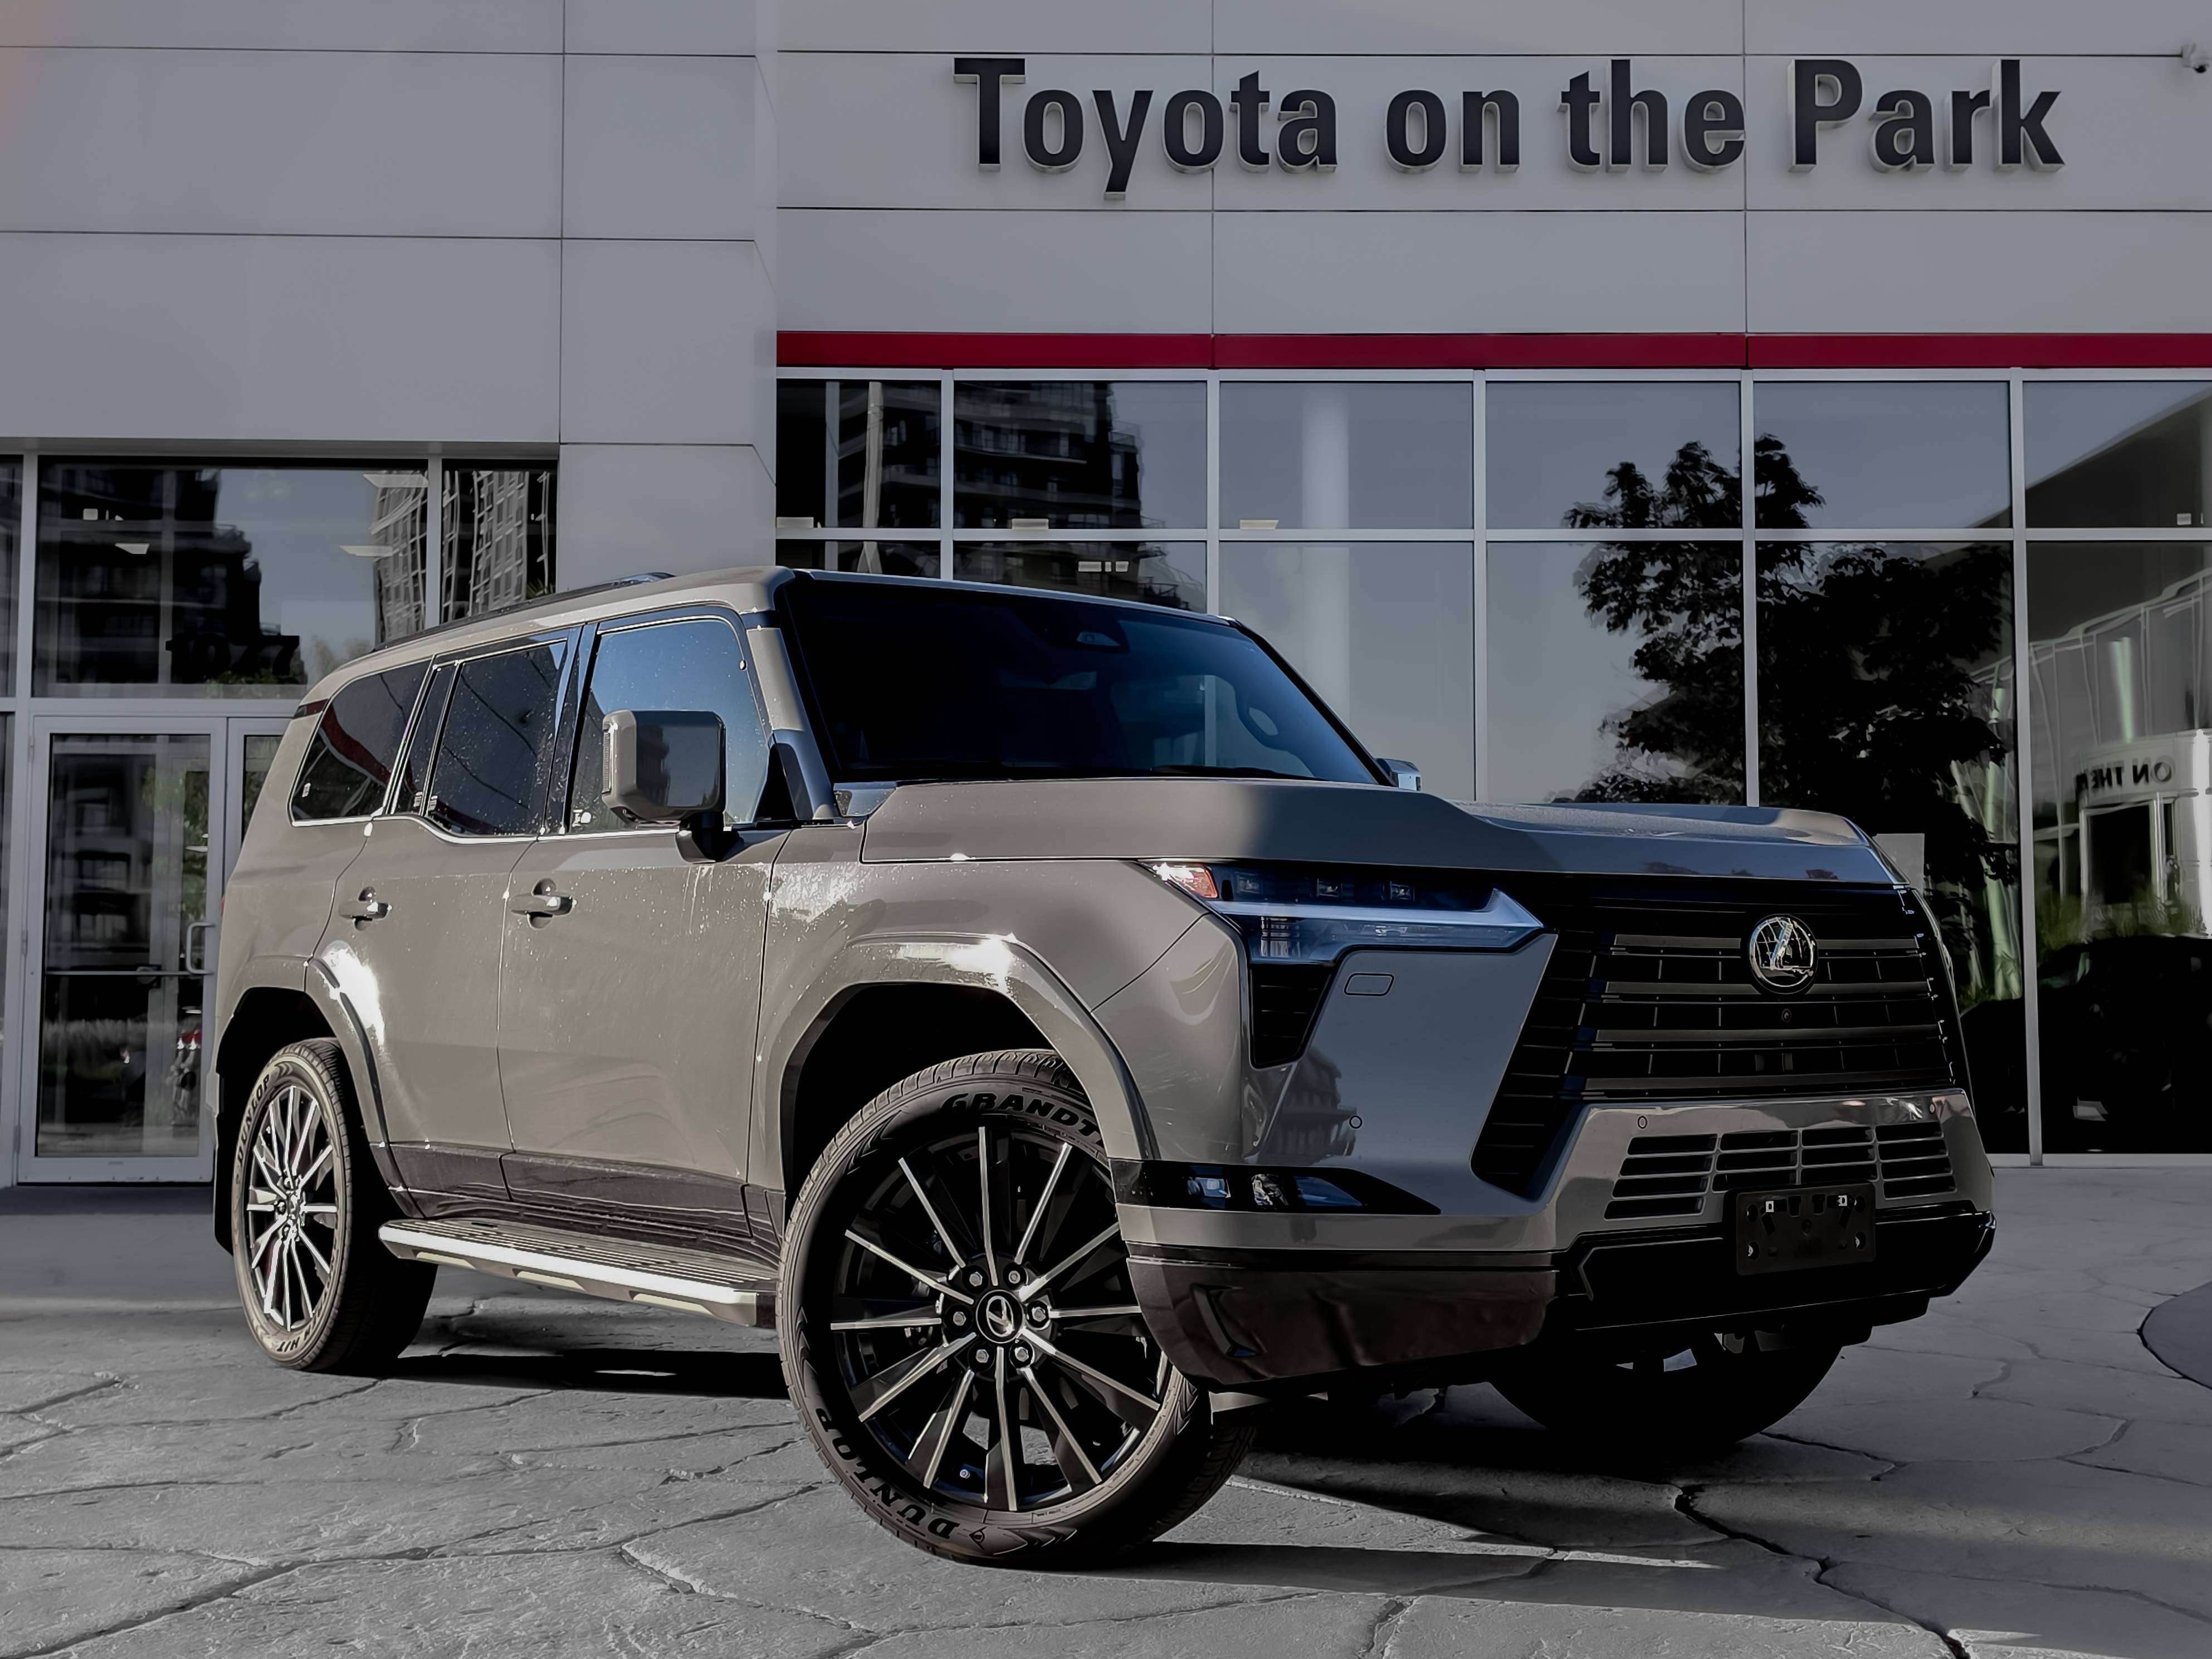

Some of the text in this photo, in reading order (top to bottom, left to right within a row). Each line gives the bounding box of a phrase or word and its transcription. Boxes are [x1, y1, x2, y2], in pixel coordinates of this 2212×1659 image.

[954, 57, 2065, 199] Toyota on the Park
[237, 1074, 270, 1168] DUNLOP
[940, 1092, 1105, 1149] GRANDT
[816, 1407, 960, 1540] DUNLOP
